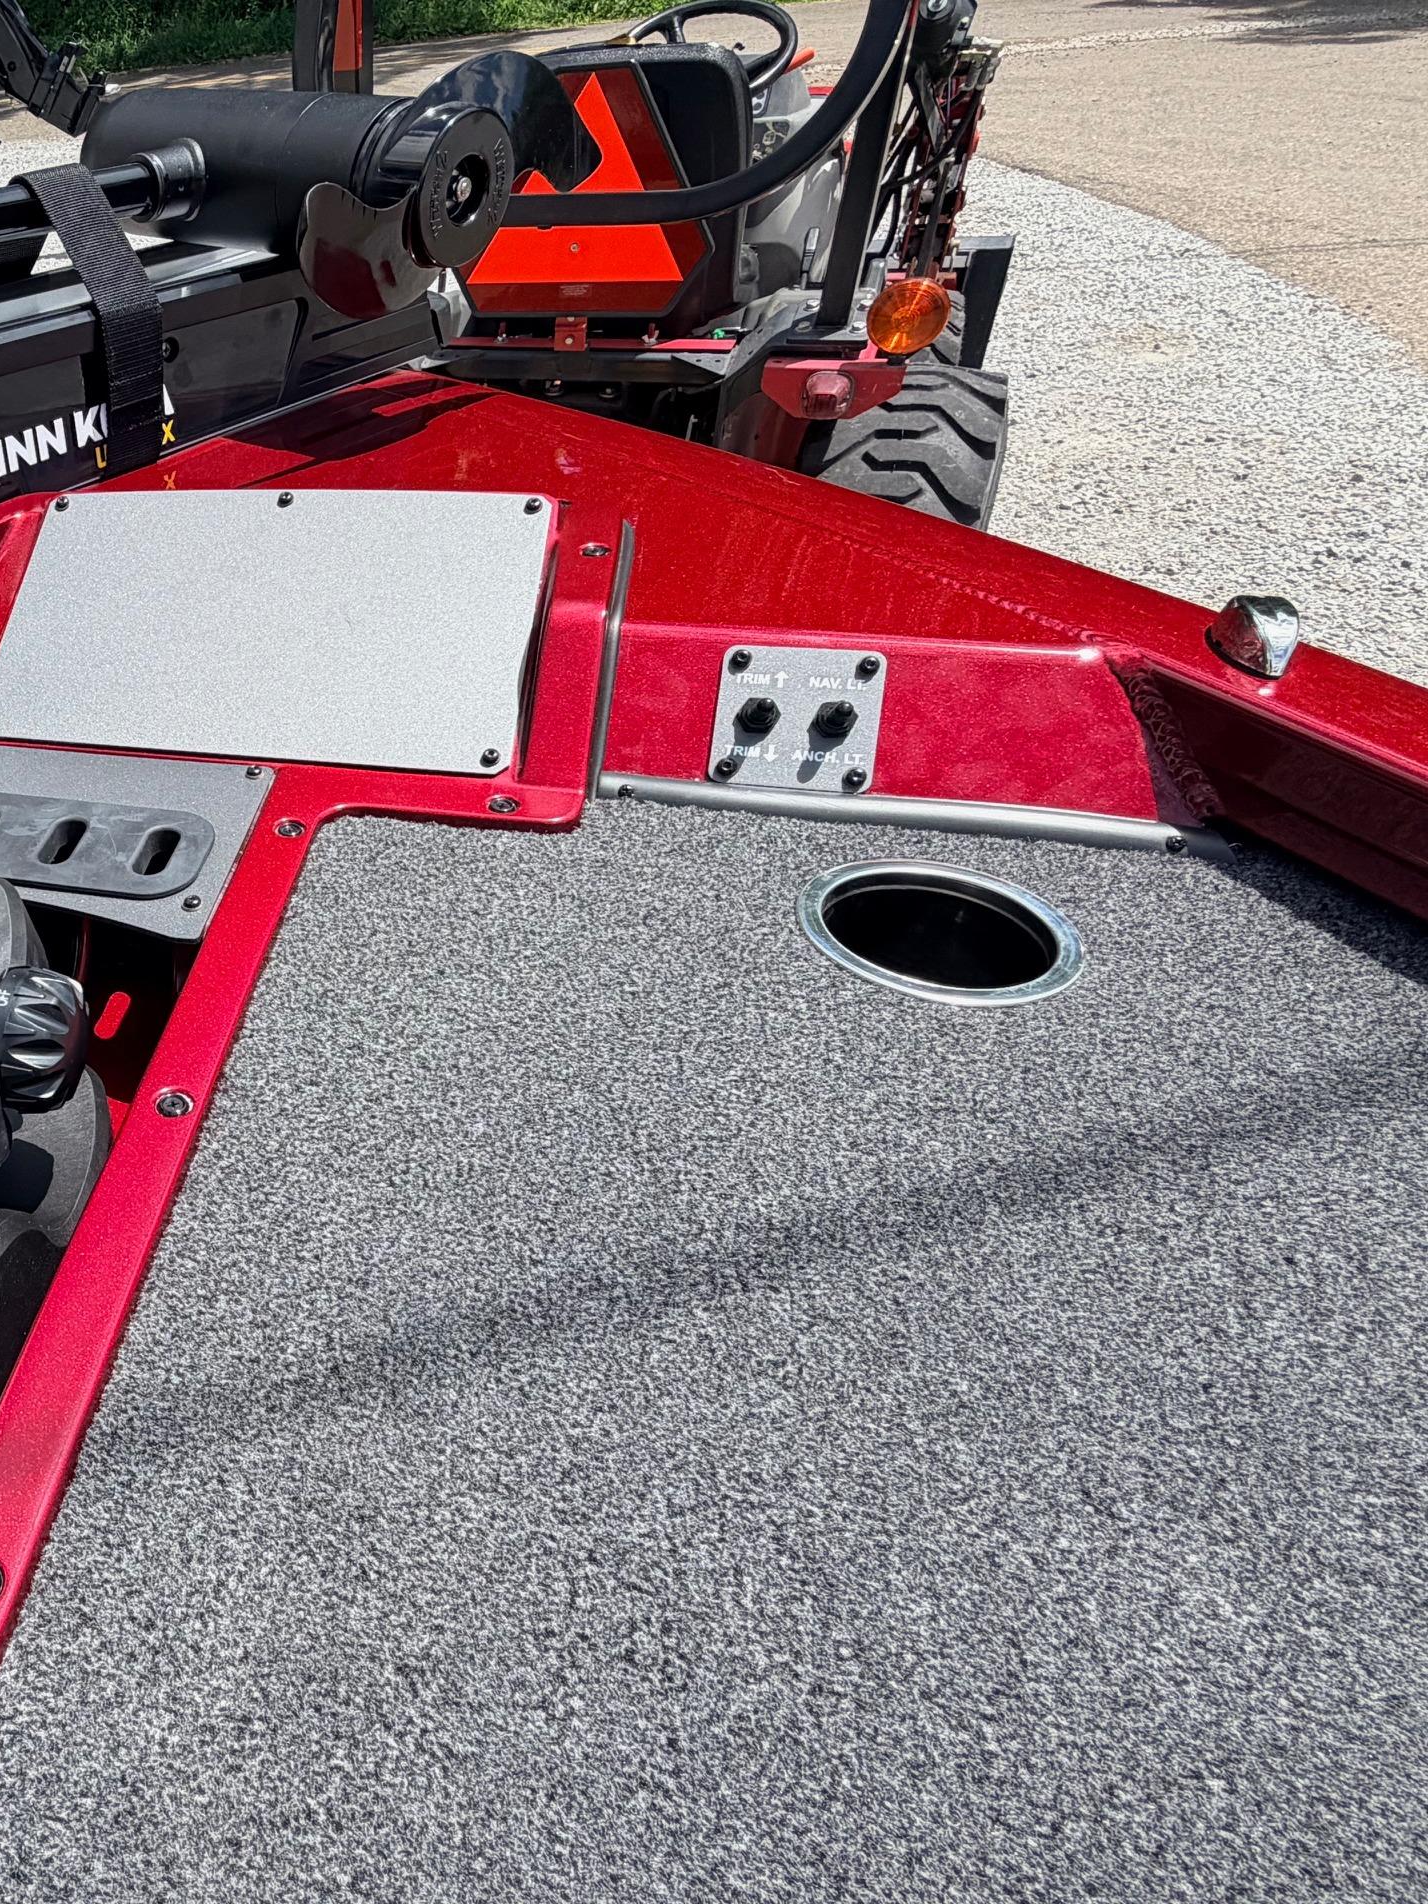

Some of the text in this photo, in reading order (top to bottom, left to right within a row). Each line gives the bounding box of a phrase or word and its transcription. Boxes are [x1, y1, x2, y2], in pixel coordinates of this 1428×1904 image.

[736, 672, 771, 686] TRIM
[809, 676, 842, 689] NAV.
[724, 744, 762, 758] TRIM
[791, 750, 864, 765] ANCH. LT.
